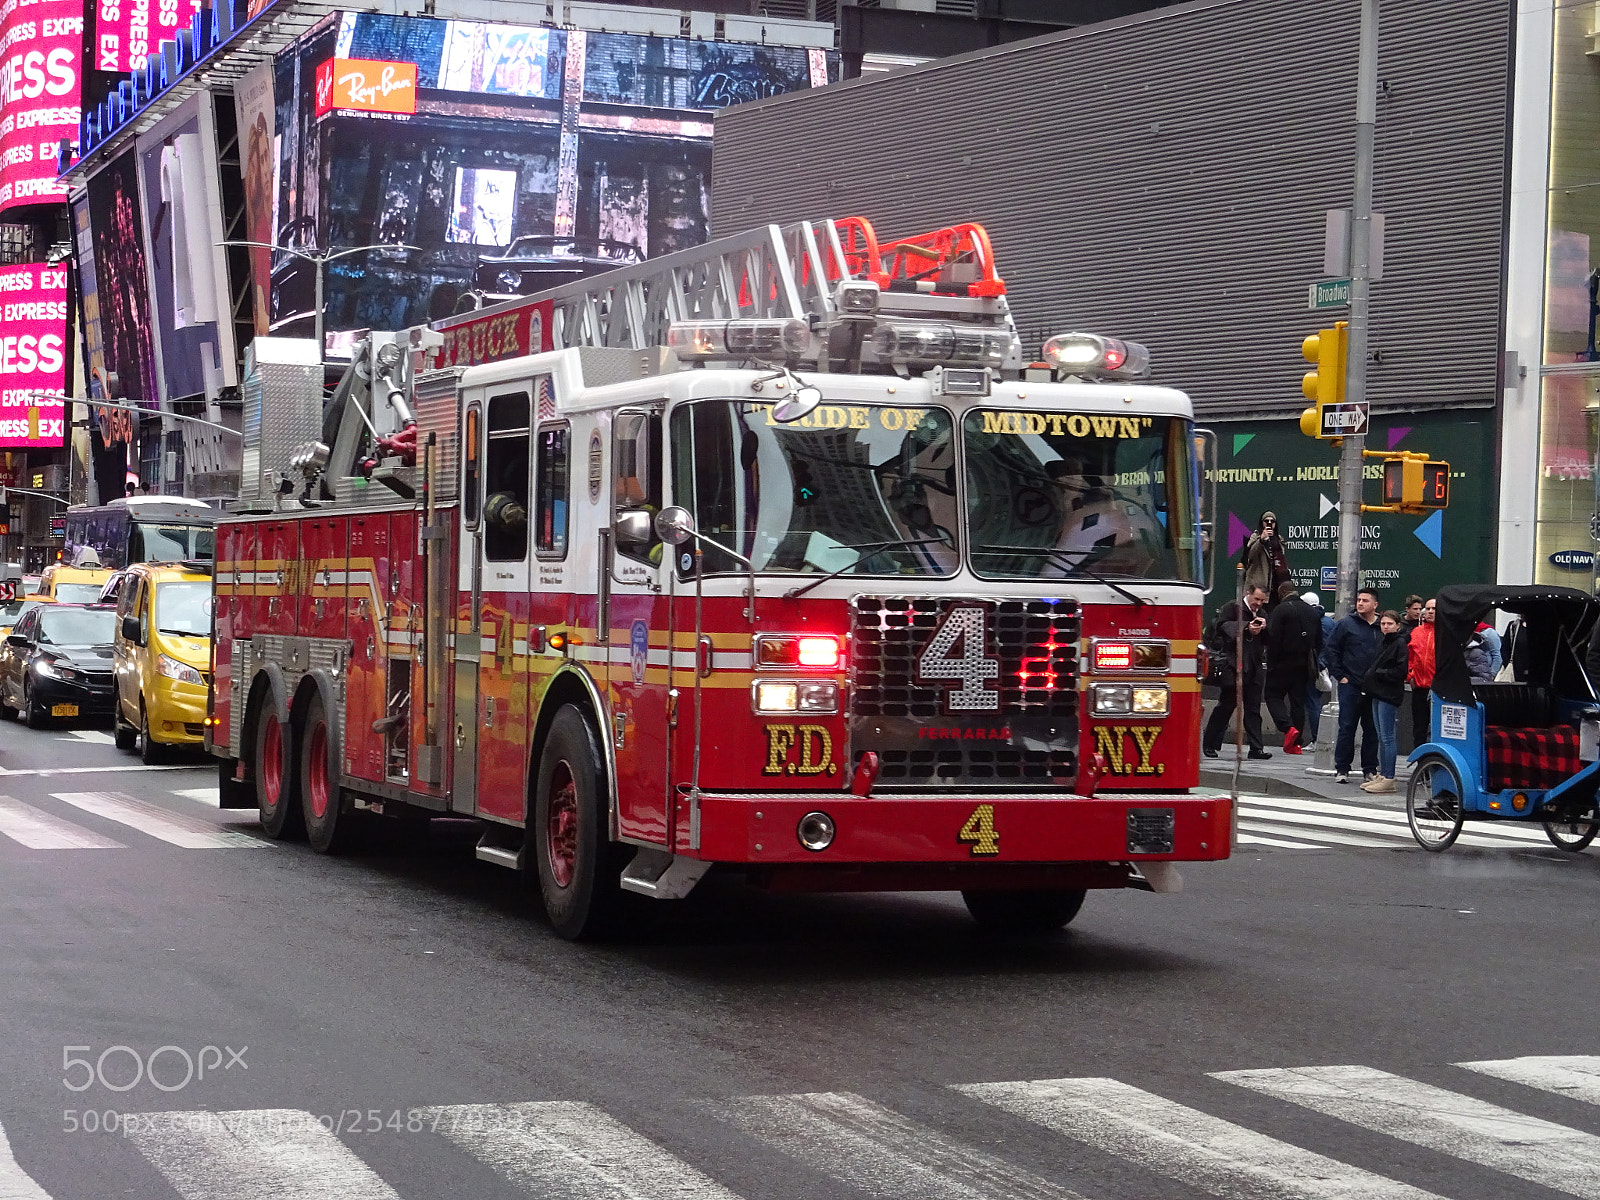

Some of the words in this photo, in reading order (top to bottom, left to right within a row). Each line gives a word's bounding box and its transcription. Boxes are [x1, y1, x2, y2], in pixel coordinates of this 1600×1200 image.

[16, 106, 82, 130] EXPRESS
[370, 112, 393, 121] SINCE
[40, 271, 67, 290] EX
[4, 301, 67, 322] EXPRESS
[442, 313, 520, 368] TRUCK
[0, 333, 63, 374] ESS
[880, 407, 925, 431] OF
[1328, 413, 1343, 426] ONE
[1348, 411, 1361, 425] WAY
[1288, 525, 1311, 539] BOW
[1312, 525, 1329, 539] TIE
[1287, 541, 1305, 550] TIMES
[1305, 541, 1329, 551] SQUARE
[1555, 555, 1571, 563] OLD
[1572, 555, 1595, 564] NAVY
[1299, 569, 1319, 577] GREEN
[918, 606, 999, 711] 4
[957, 803, 1000, 856] 4
